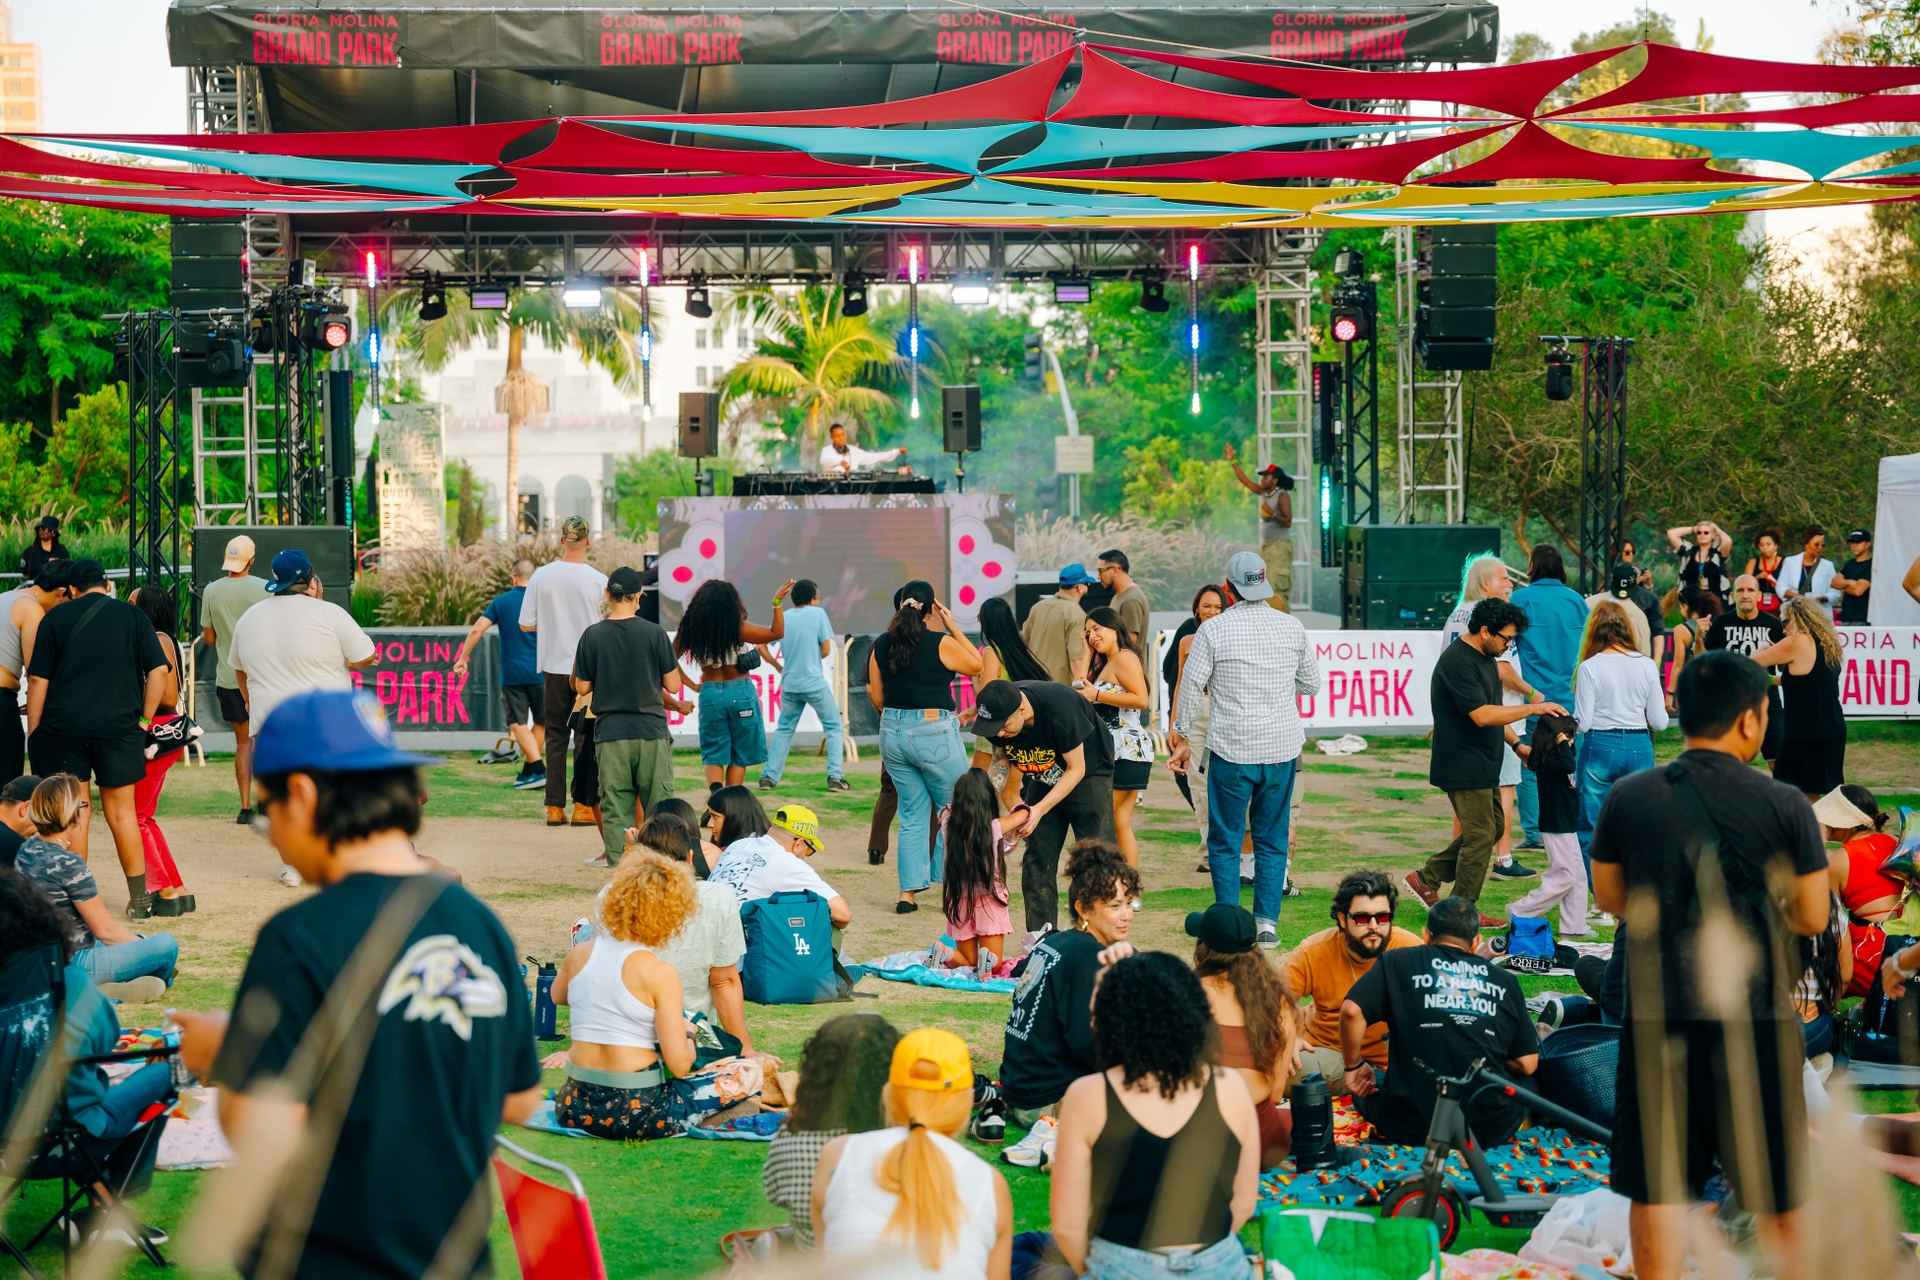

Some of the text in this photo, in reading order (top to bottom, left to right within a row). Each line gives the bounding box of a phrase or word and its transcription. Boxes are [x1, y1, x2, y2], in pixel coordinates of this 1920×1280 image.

[253, 13, 398, 28] GLORIA MOLINA
[601, 14, 742, 28] GLORIA MOLINA
[938, 13, 1077, 27] GLORIA MOLINA
[1272, 13, 1408, 26] GLORIA MOLINA
[253, 31, 398, 65] GRAND PARK
[600, 32, 742, 65] GRAND PARK
[937, 31, 1011, 63] GRAND
[1270, 30, 1408, 61] GRAND PARK
[382, 487, 440, 500] everyone
[1724, 626, 1771, 641] THANK
[1838, 631, 1895, 649] ORIA
[1316, 642, 1413, 660] MOLINA
[1842, 659, 1910, 705] AND
[376, 671, 470, 723] PARK
[1328, 669, 1414, 718] PARK
[793, 933, 810, 955] LA
[1432, 958, 1488, 976] COMING
[1510, 957, 1547, 970] TERRA
[1412, 974, 1506, 1001] TO A REALITY
[1424, 994, 1497, 1016] NEAR YOU
